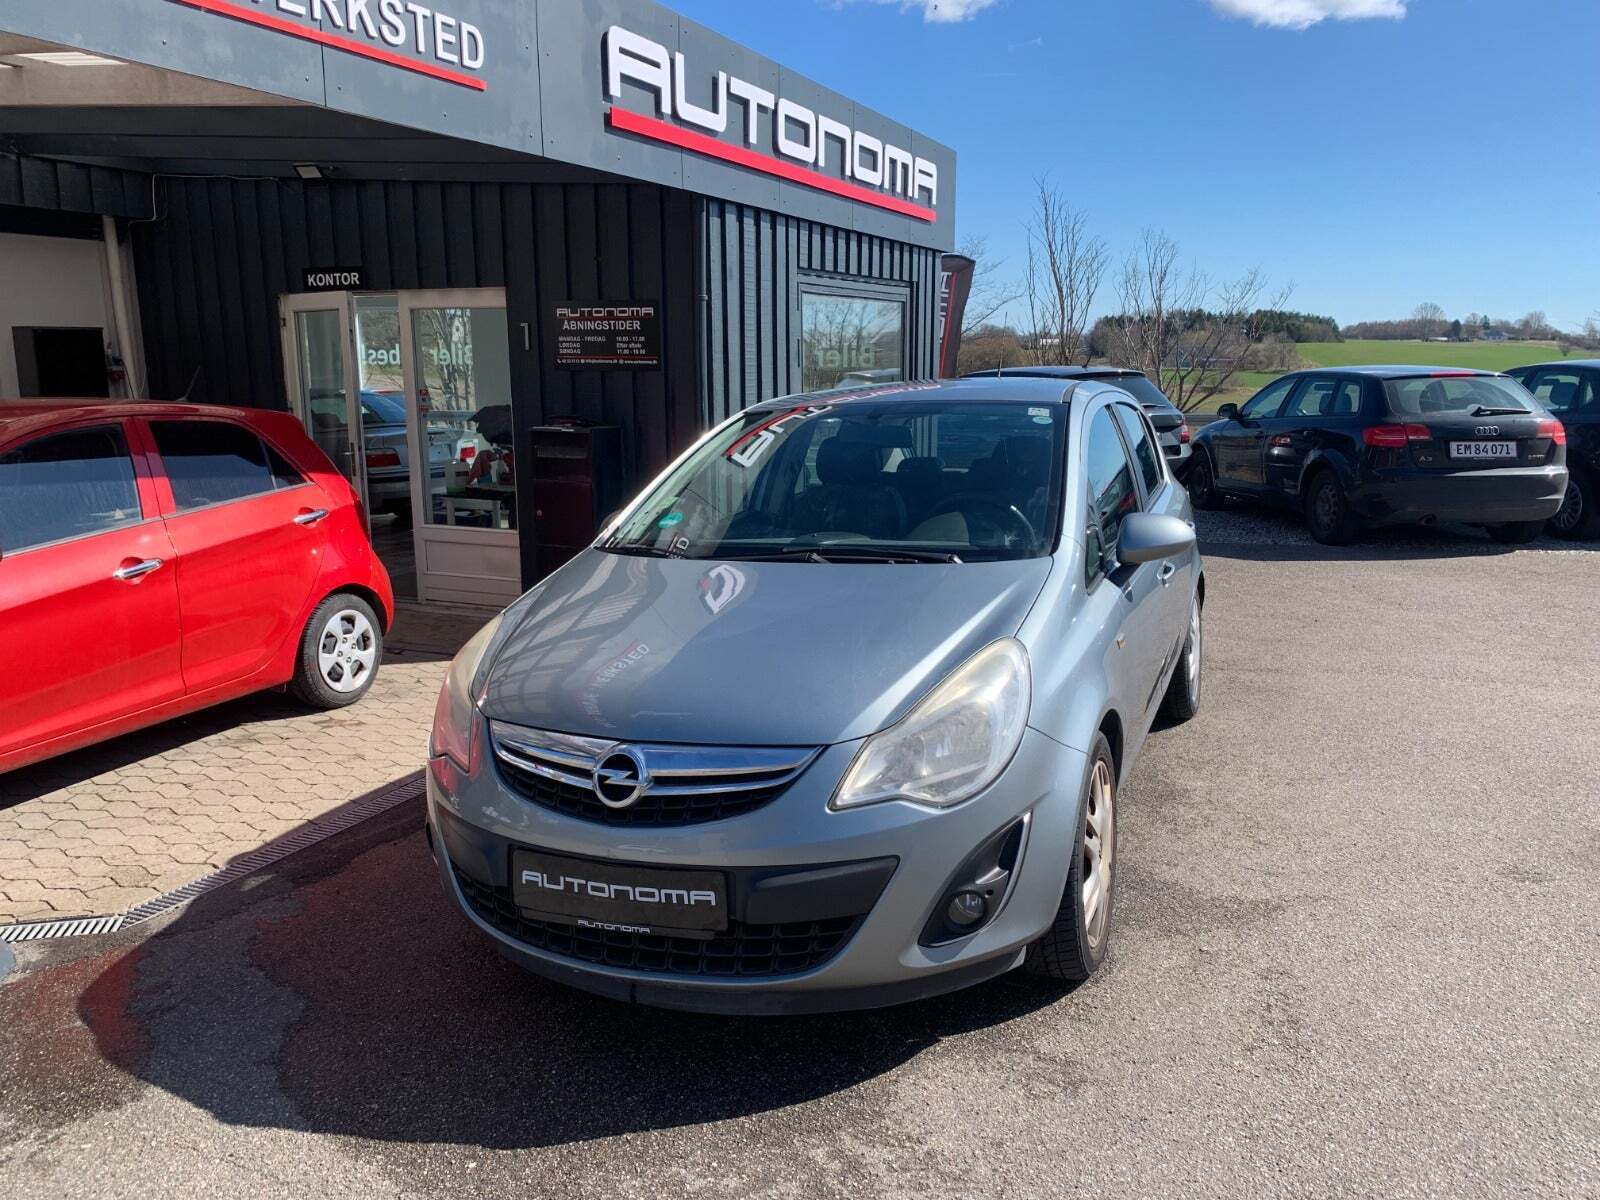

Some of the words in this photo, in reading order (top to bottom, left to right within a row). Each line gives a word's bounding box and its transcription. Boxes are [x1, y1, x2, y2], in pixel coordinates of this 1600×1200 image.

[607, 25, 937, 206] AUTONOMA
[307, 272, 360, 287] KONTOR
[556, 307, 654, 318] AUTONOMA
[563, 319, 641, 331] ÅBNINGSTIDER
[521, 869, 717, 906] AUTONOMA
[577, 919, 651, 934] AUTONOMA
